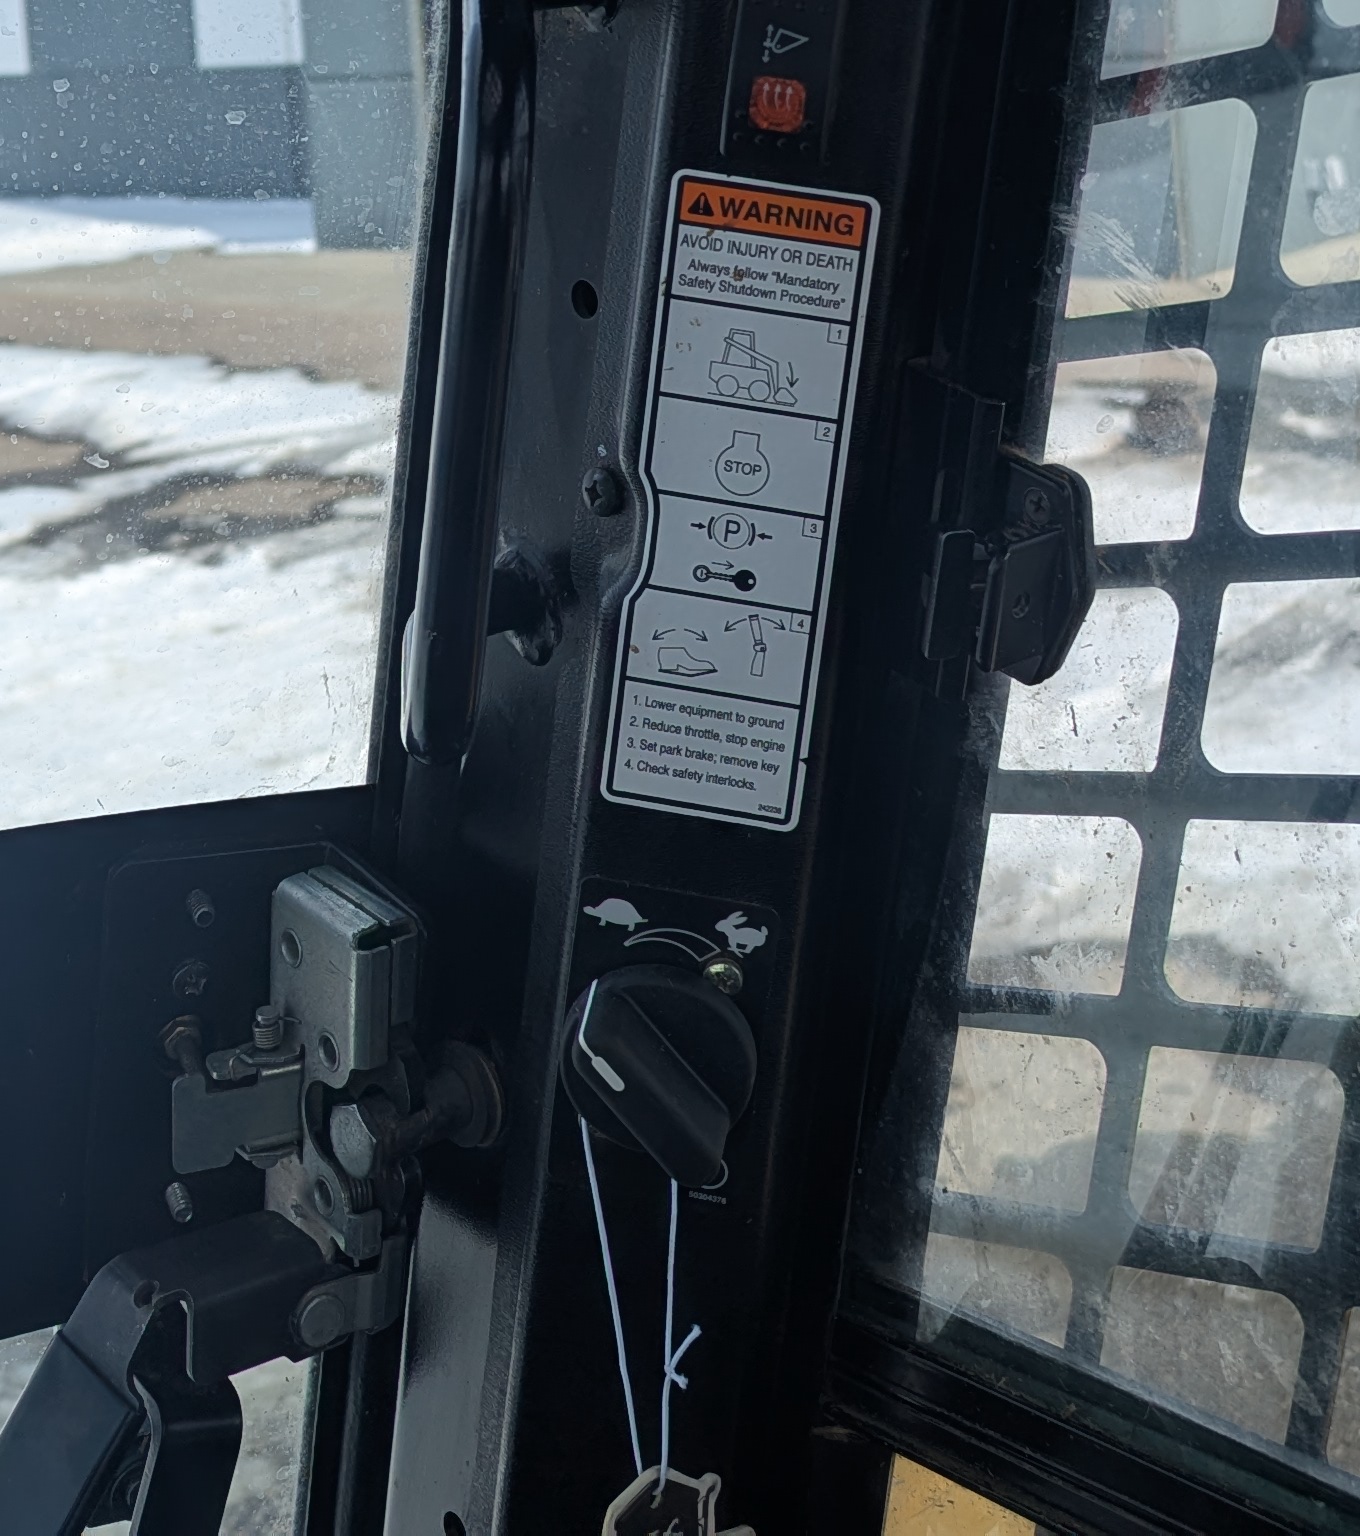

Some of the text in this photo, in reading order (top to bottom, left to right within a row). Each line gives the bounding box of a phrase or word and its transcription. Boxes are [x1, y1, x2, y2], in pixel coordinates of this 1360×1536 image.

[718, 195, 855, 237] WARNING
[679, 232, 855, 273] AVOID INJURY OR DEATH
[687, 258, 731, 280] Always
[733, 264, 769, 282] follow
[677, 273, 717, 294] Safety
[718, 279, 777, 301] Shutdown
[836, 329, 842, 339] 1
[823, 427, 831, 438] 2
[723, 459, 762, 477] STOP
[723, 519, 741, 543] P
[809, 523, 818, 534] 3
[798, 619, 805, 629] 4
[632, 695, 785, 731] 1. Lower equipment to ground
[629, 716, 786, 754] 2. Reduce throttle, stop engine
[626, 736, 637, 750] 3.
[639, 739, 658, 753] Set
[659, 743, 683, 760] park
[719, 754, 759, 770] remove
[760, 759, 780, 776] key
[624, 758, 757, 791] 4. Check safety interlocks.
